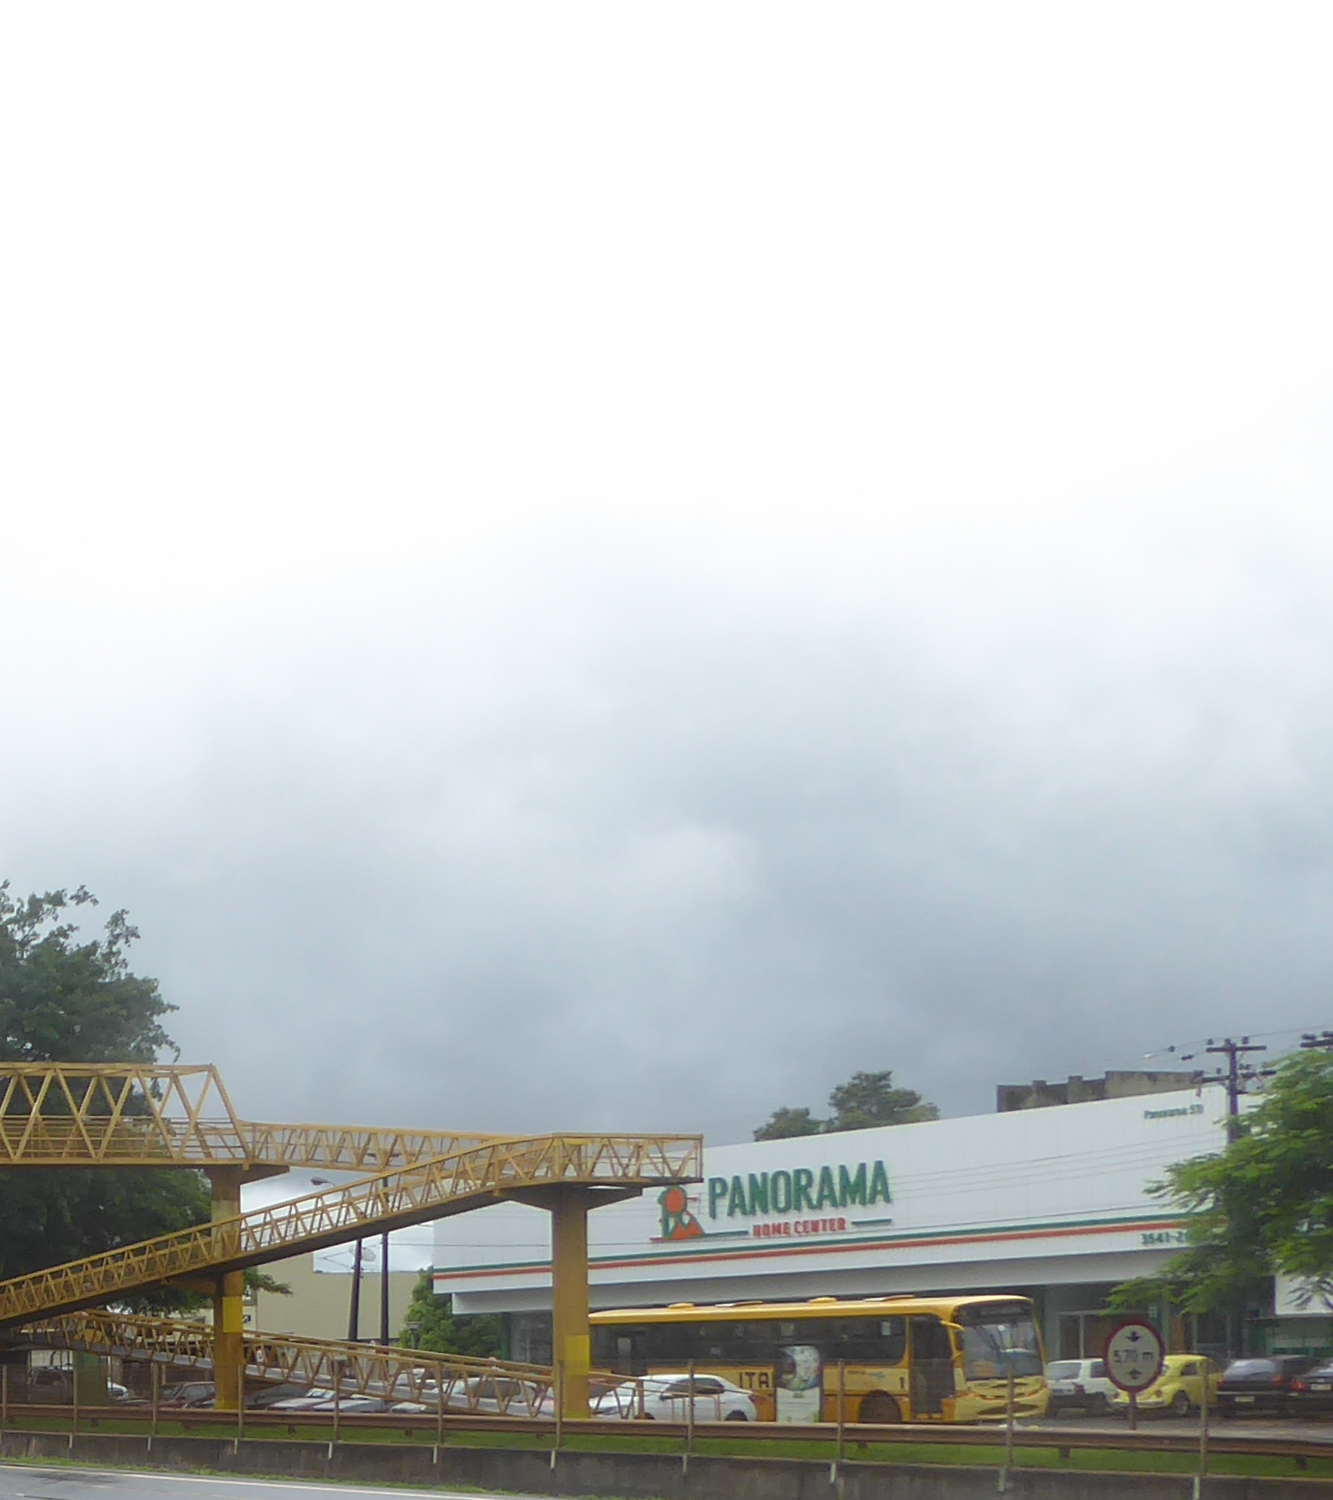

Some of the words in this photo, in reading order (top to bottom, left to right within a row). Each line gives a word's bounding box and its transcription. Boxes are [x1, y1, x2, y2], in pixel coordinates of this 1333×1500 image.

[708, 1160, 893, 1220] PANORAMA
[753, 1220, 790, 1237] HOME
[794, 1217, 846, 1234] CENTER
